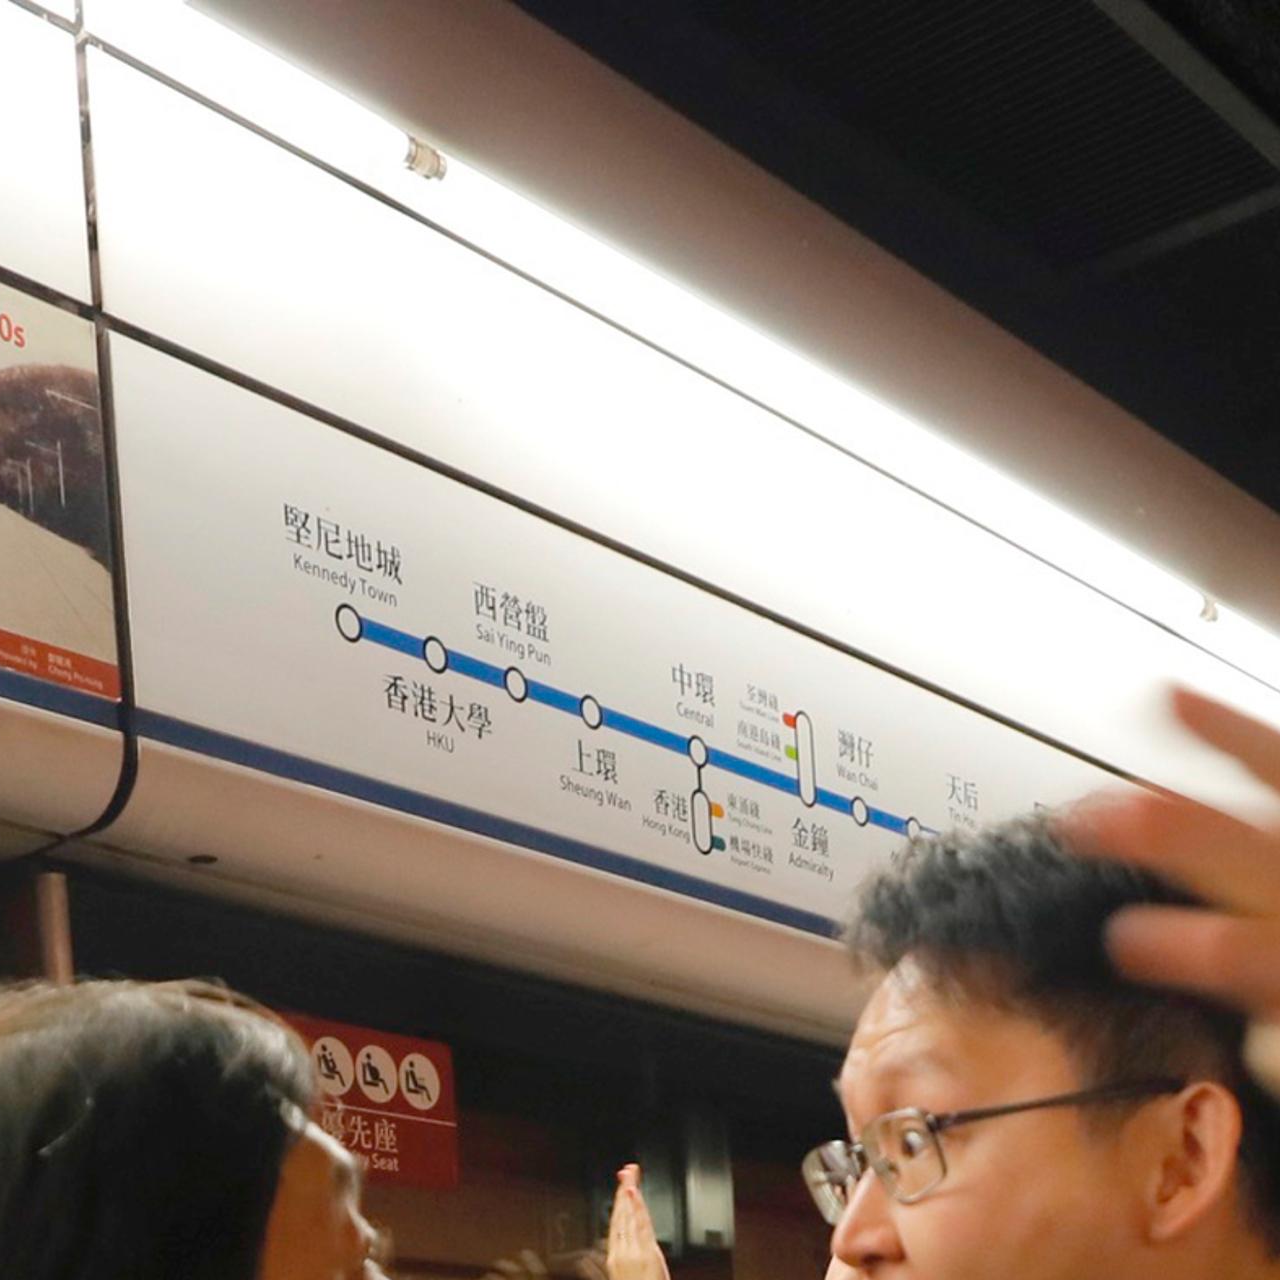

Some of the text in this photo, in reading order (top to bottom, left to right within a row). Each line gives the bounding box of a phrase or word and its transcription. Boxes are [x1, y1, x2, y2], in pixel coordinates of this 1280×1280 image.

[283, 502, 403, 585] 堅尼地城
[293, 552, 398, 607] Kennedy Town
[472, 580, 550, 643] 西營盤
[476, 622, 552, 667] Sai Ying Pun
[671, 663, 716, 708] 中環
[383, 674, 493, 740] 香港大學
[676, 702, 715, 729] Central
[426, 730, 455, 754] HKU
[837, 729, 874, 769] 灣仔
[572, 739, 619, 785] 上環
[835, 763, 879, 792] Wan Chai
[560, 774, 632, 811] Sheung Wan
[655, 789, 688, 823] 香港
[945, 772, 979, 811] 天后
[642, 814, 691, 845] Hong Kong
[792, 817, 829, 859] 金鐘
[788, 851, 835, 882] Admiralty
[371, 1152, 400, 1172] Seat
